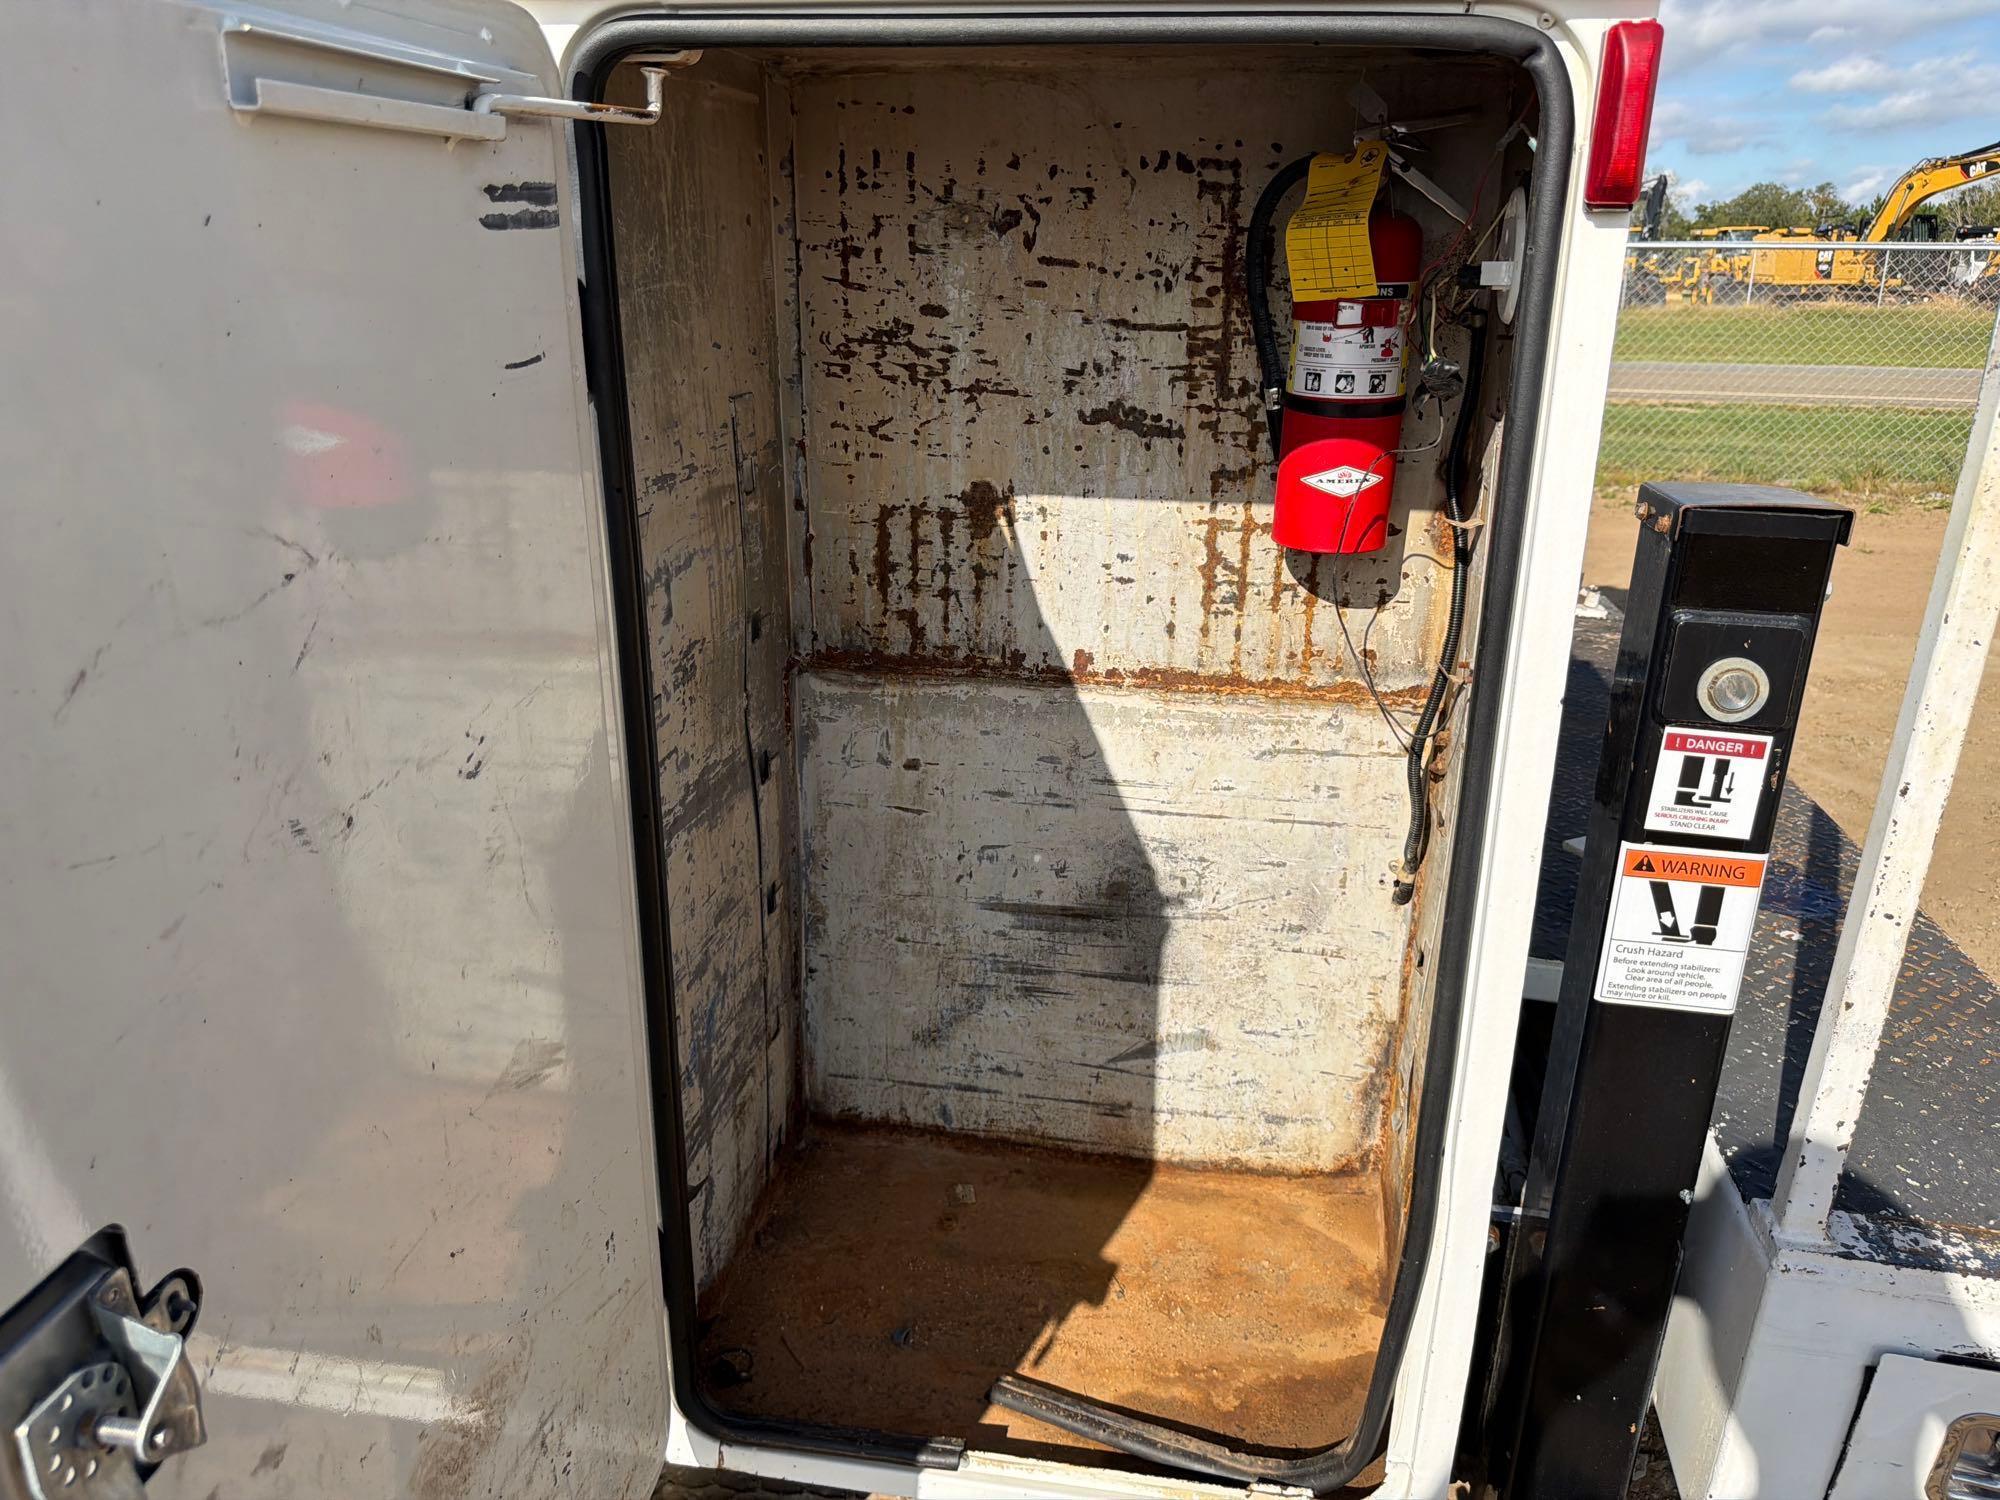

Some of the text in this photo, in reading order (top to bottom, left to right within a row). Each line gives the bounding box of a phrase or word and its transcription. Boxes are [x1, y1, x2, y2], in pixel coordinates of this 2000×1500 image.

[1969, 161, 1987, 177] CAT
[1818, 250, 1833, 262] CAT
[1686, 738, 1744, 754] DANGER
[1661, 806, 1694, 814] STABILIZERS
[1662, 859, 1746, 880] WARNING
[1616, 944, 1684, 958] Crush Hazard
[1613, 956, 1720, 973] Before extending stabilizers:
[1627, 966, 1706, 980] Look around vehicle.
[1625, 974, 1644, 982] Clear
[1684, 981, 1713, 989] people.
[1608, 982, 1646, 992] Extending
[1648, 986, 1686, 996] stabilizers
[1700, 992, 1727, 1000] people
[1624, 991, 1646, 999] injure
